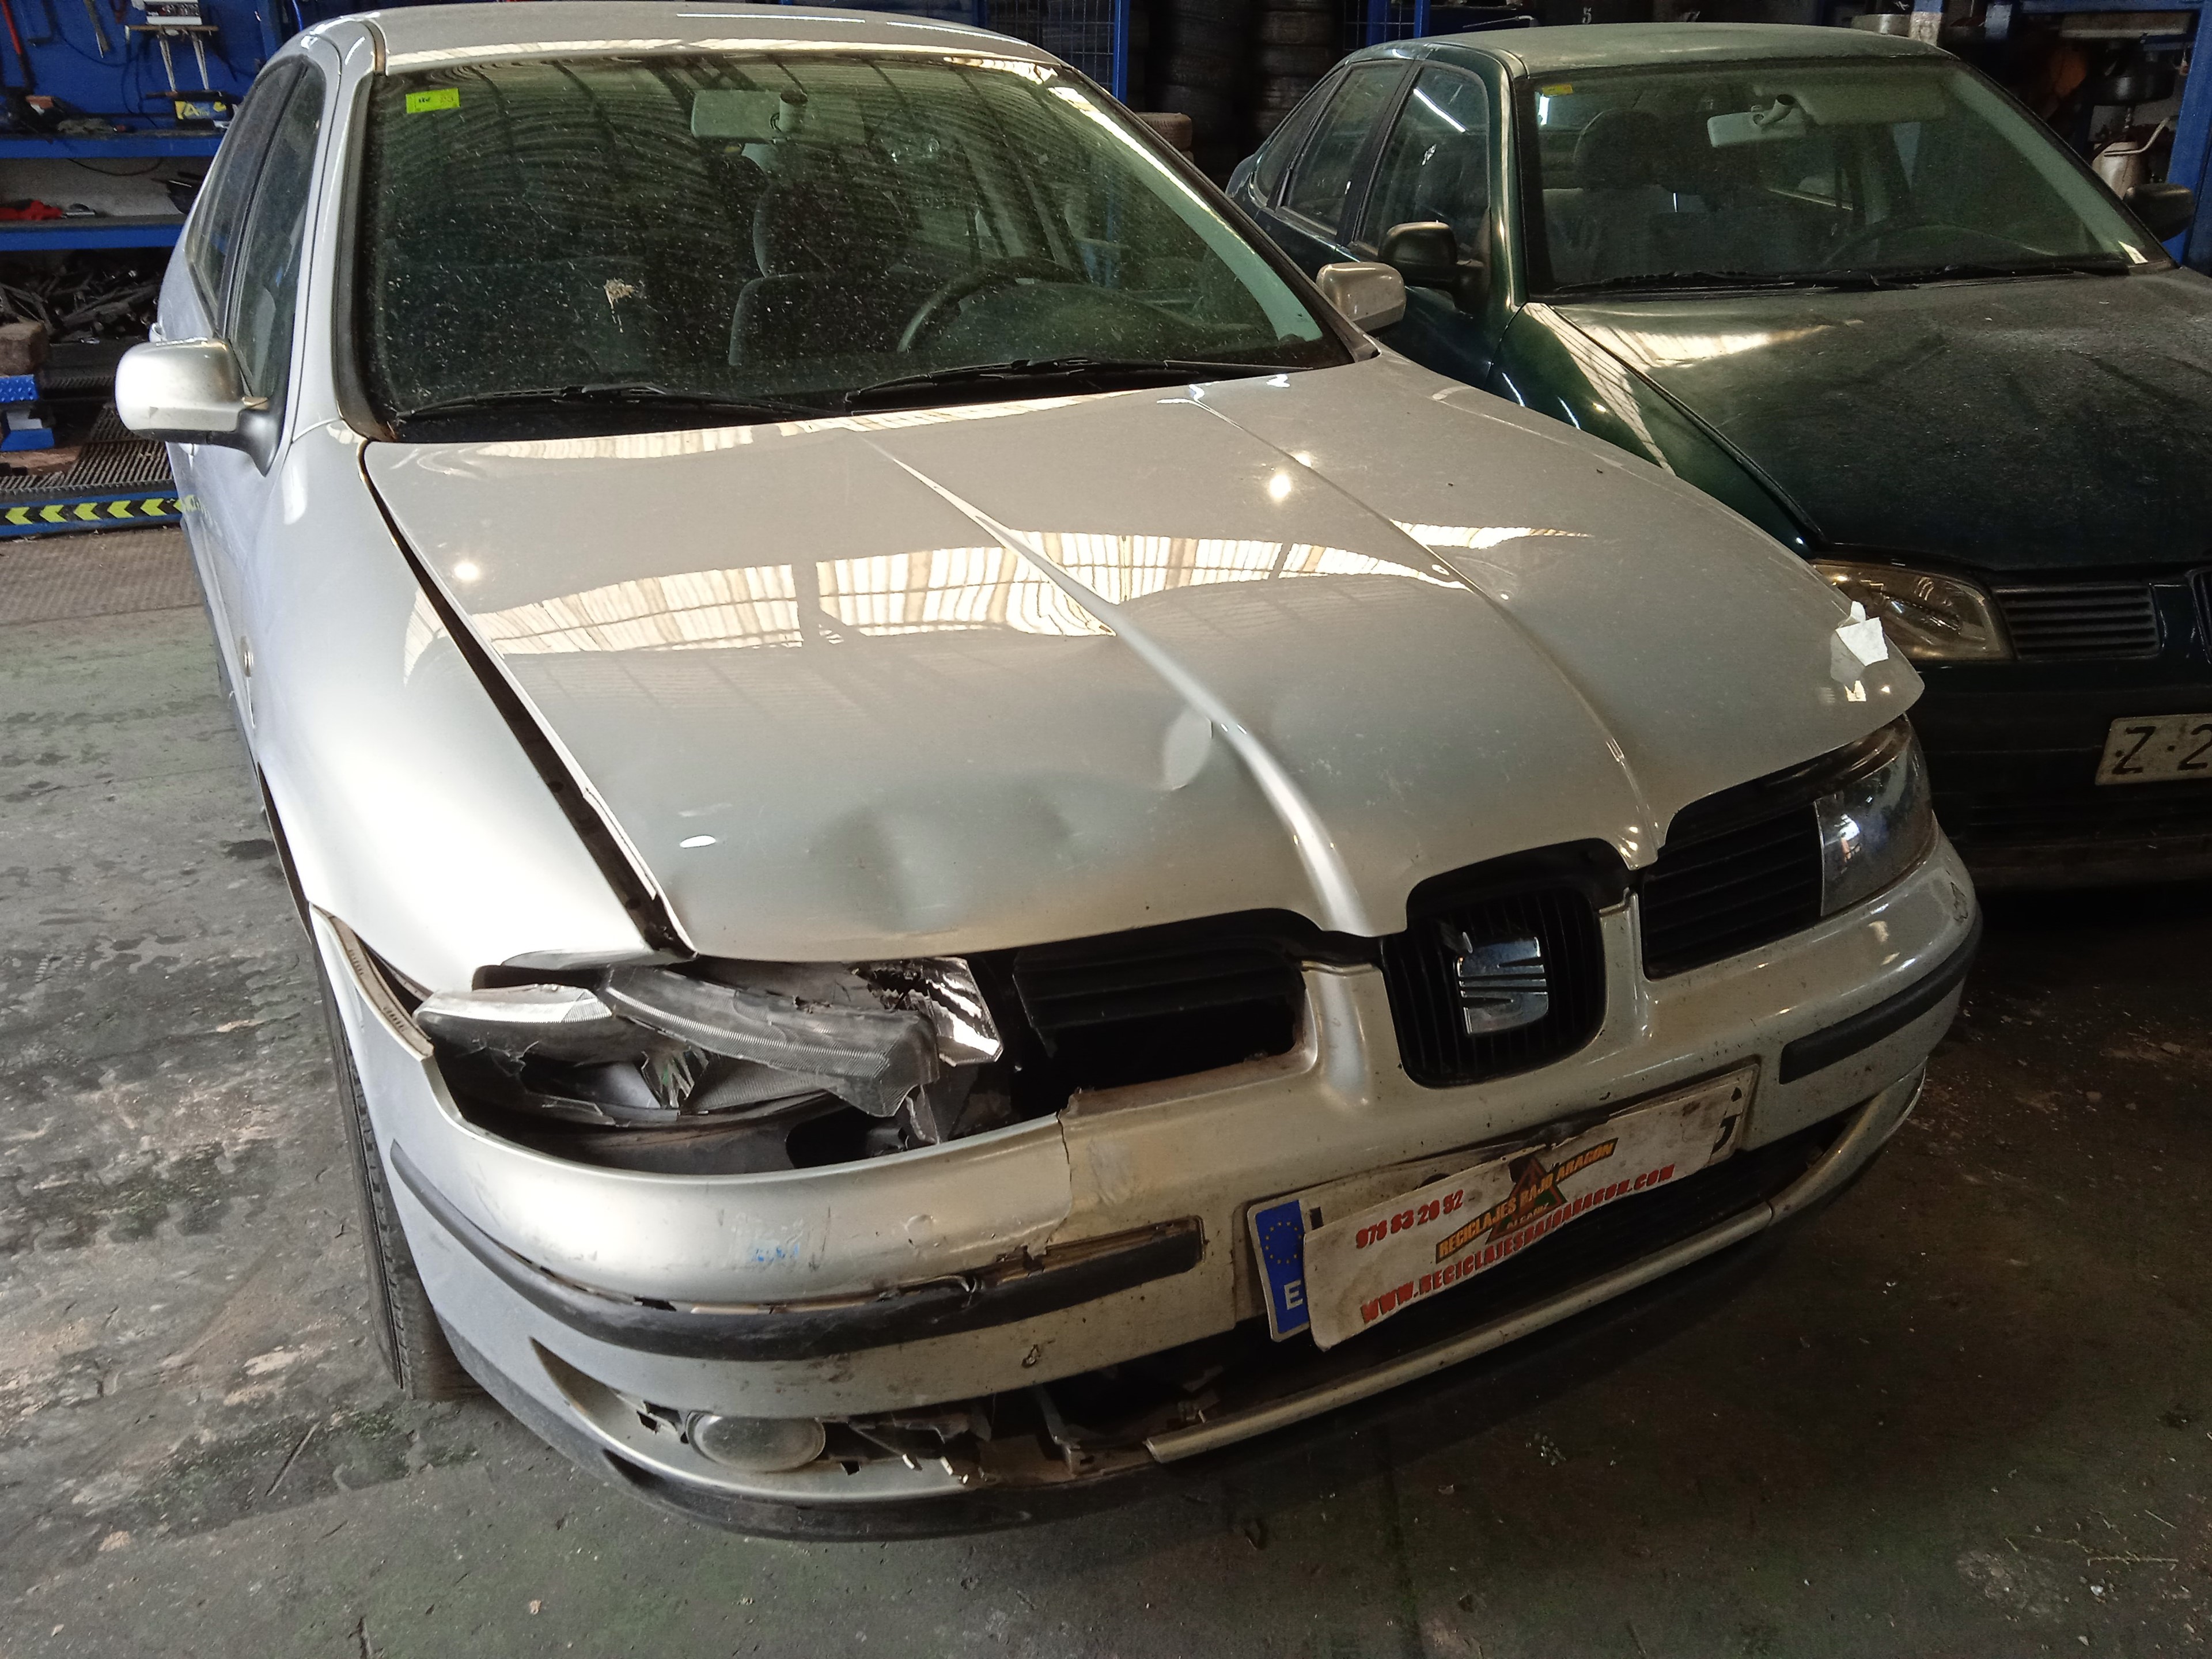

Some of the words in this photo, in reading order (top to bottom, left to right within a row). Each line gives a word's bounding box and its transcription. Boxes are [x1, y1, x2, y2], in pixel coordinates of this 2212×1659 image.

[1417, 1199, 1440, 1226] 20
[1439, 1196, 1517, 1256] RECICLAJES
[1284, 1279, 1304, 1310] E
